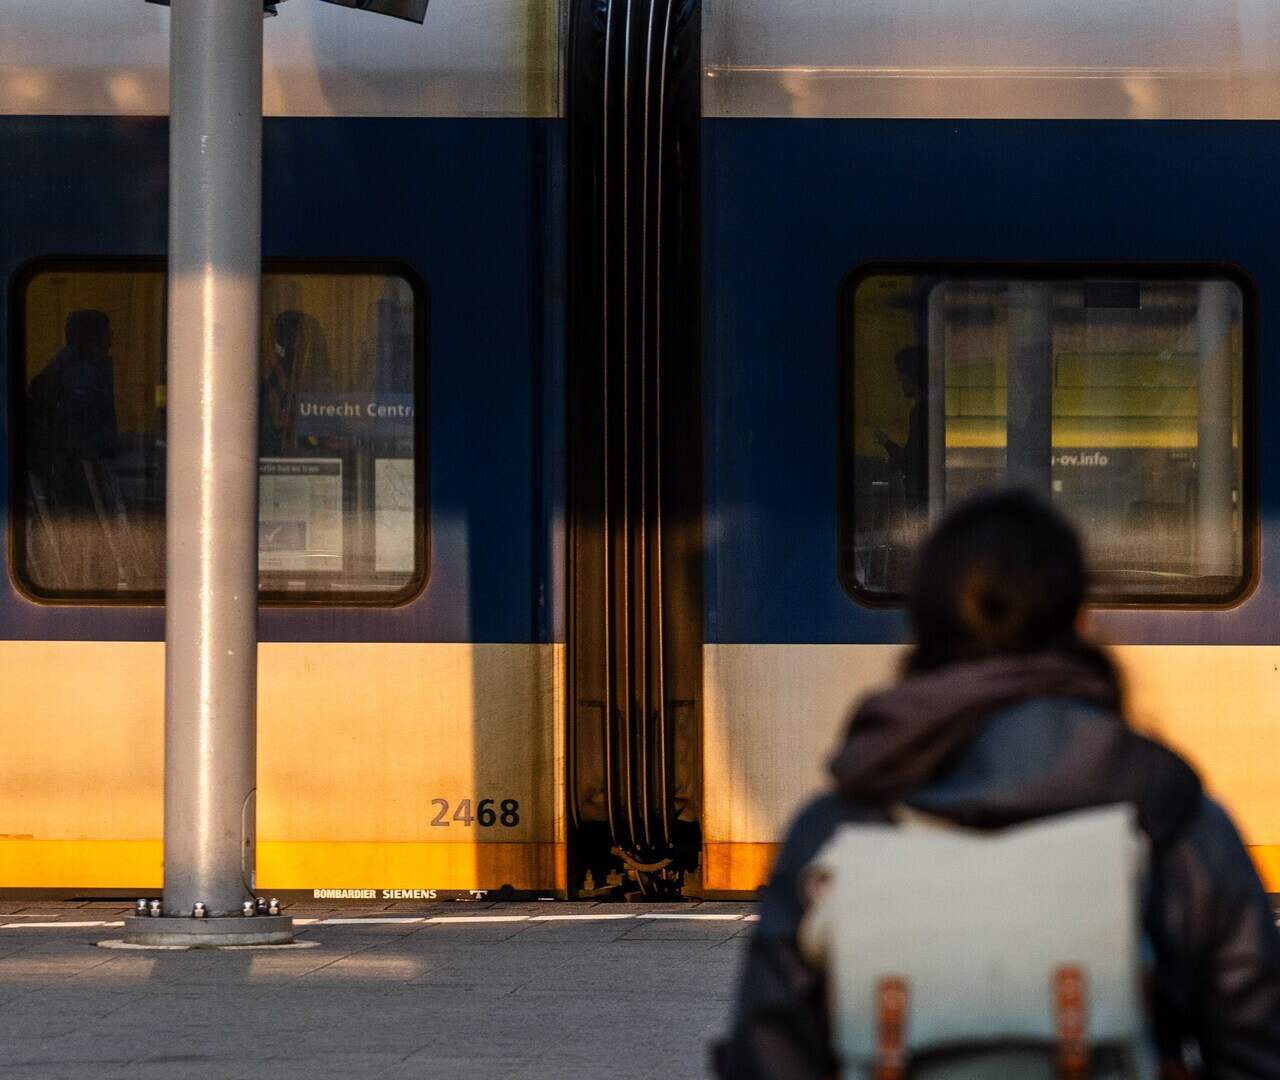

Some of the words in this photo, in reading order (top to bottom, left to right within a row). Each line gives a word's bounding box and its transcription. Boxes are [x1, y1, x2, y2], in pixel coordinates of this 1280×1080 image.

[300, 402, 361, 417] Utrecht
[430, 798, 520, 828] 2468
[313, 889, 377, 900] BOMBARDIER
[382, 889, 438, 900] SIEMENS
